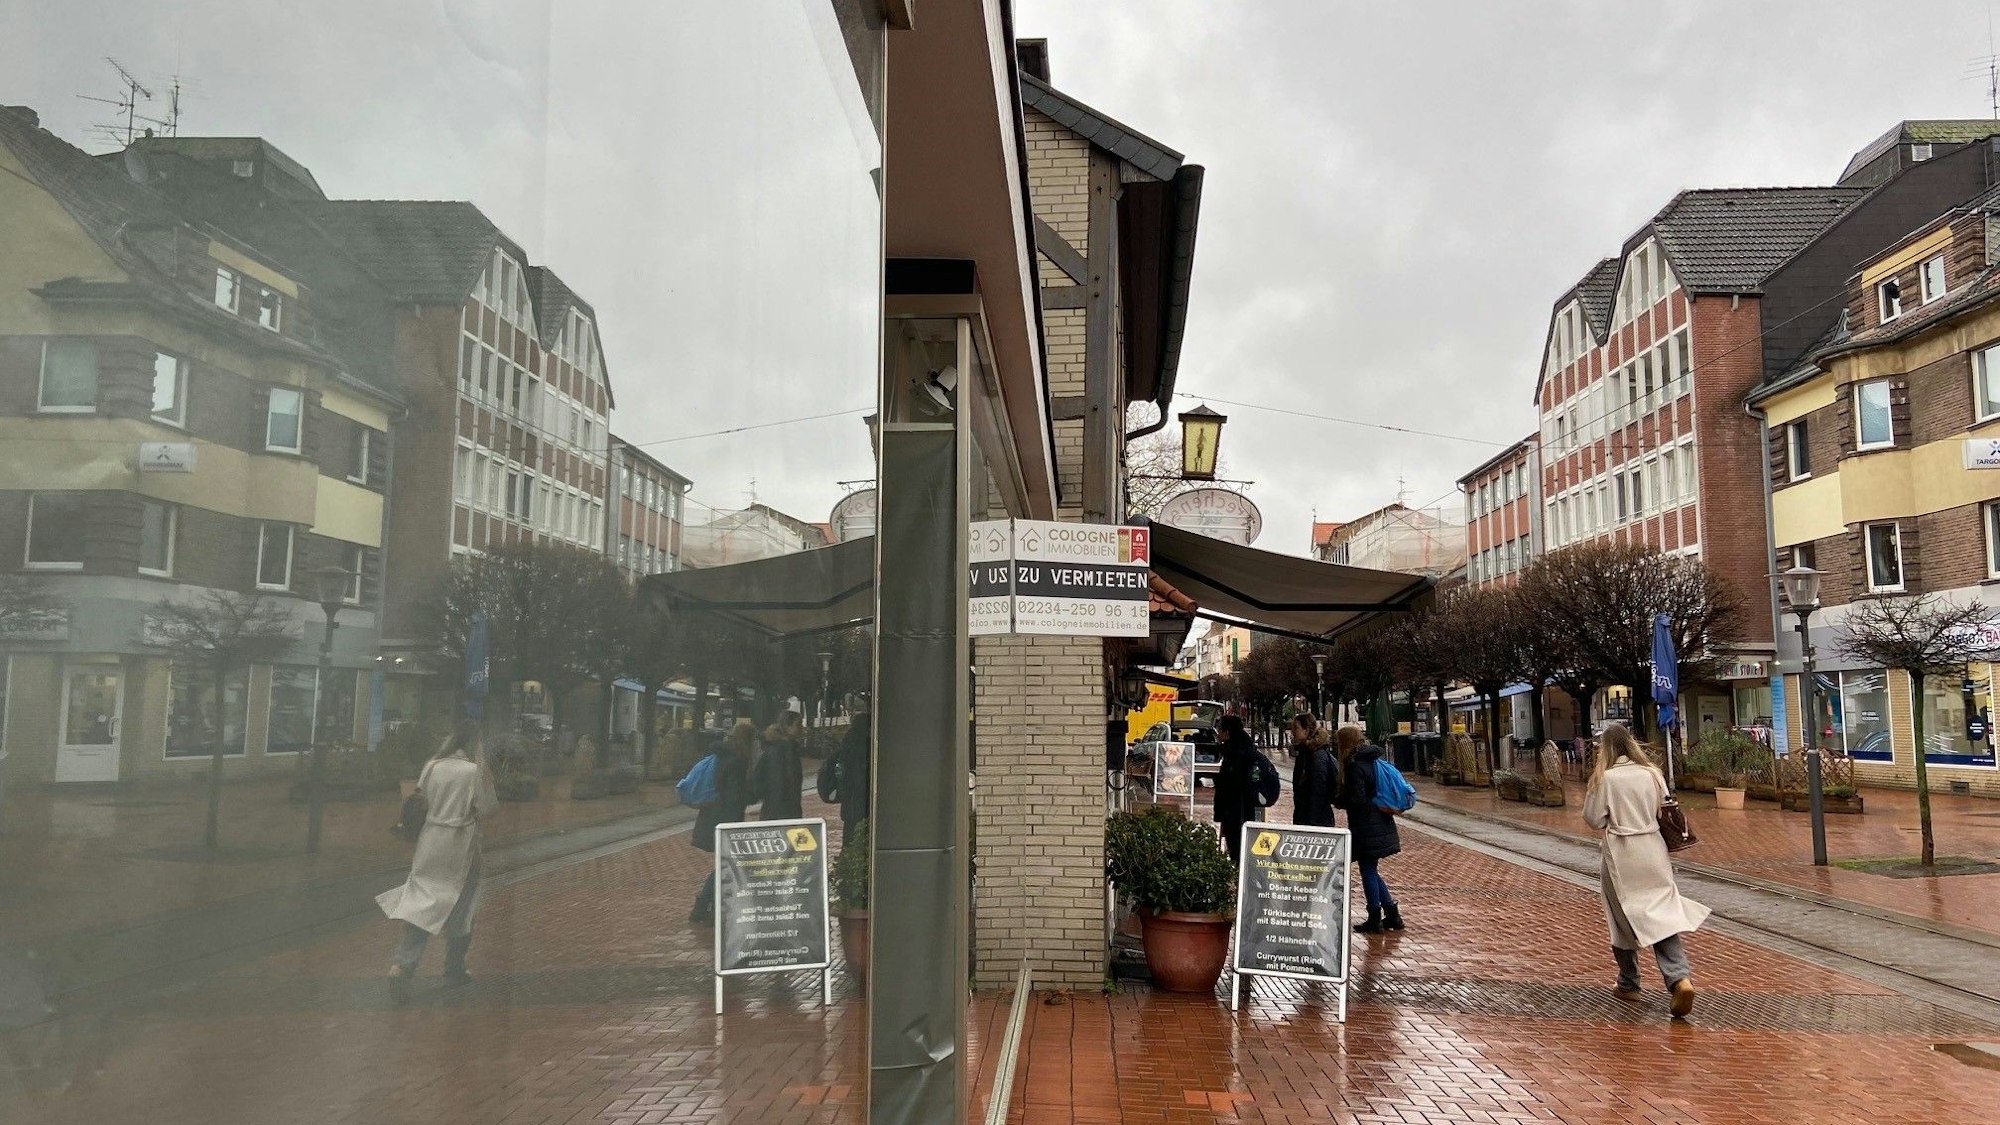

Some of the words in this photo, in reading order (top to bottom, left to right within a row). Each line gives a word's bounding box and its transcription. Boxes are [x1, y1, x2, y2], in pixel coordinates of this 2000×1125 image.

[1048, 528, 1116, 544] COLOGNE
[1048, 543, 1116, 557] IMMOBILIEN
[1019, 567, 1040, 584] ZU
[1050, 568, 1148, 589] VERMIETEN
[1018, 600, 1096, 617] 02234-250
[1105, 603, 1122, 617] 96
[1131, 605, 1148, 618] 15
[1019, 618, 1148, 630] www.cologneimmobilien.de
[1284, 834, 1337, 846] FRECHENER
[1279, 843, 1337, 860] GRILL
[1269, 883, 1292, 892] Döner
[1258, 891, 1271, 899] mit
[1271, 892, 1291, 901] Salat
[1292, 894, 1307, 903] und
[1263, 908, 1300, 919] Türkische
[1302, 911, 1322, 921] Pizza
[1256, 917, 1269, 925] mit
[1270, 918, 1290, 927] Salat
[1291, 919, 1306, 928] und
[1265, 934, 1277, 943] 1/2
[1278, 935, 1317, 946] Hähnchen
[1256, 952, 1300, 963] Currywurst
[1300, 955, 1325, 967] (Rind)
[1266, 962, 1279, 970] mit
[1280, 963, 1314, 974] Pommes
